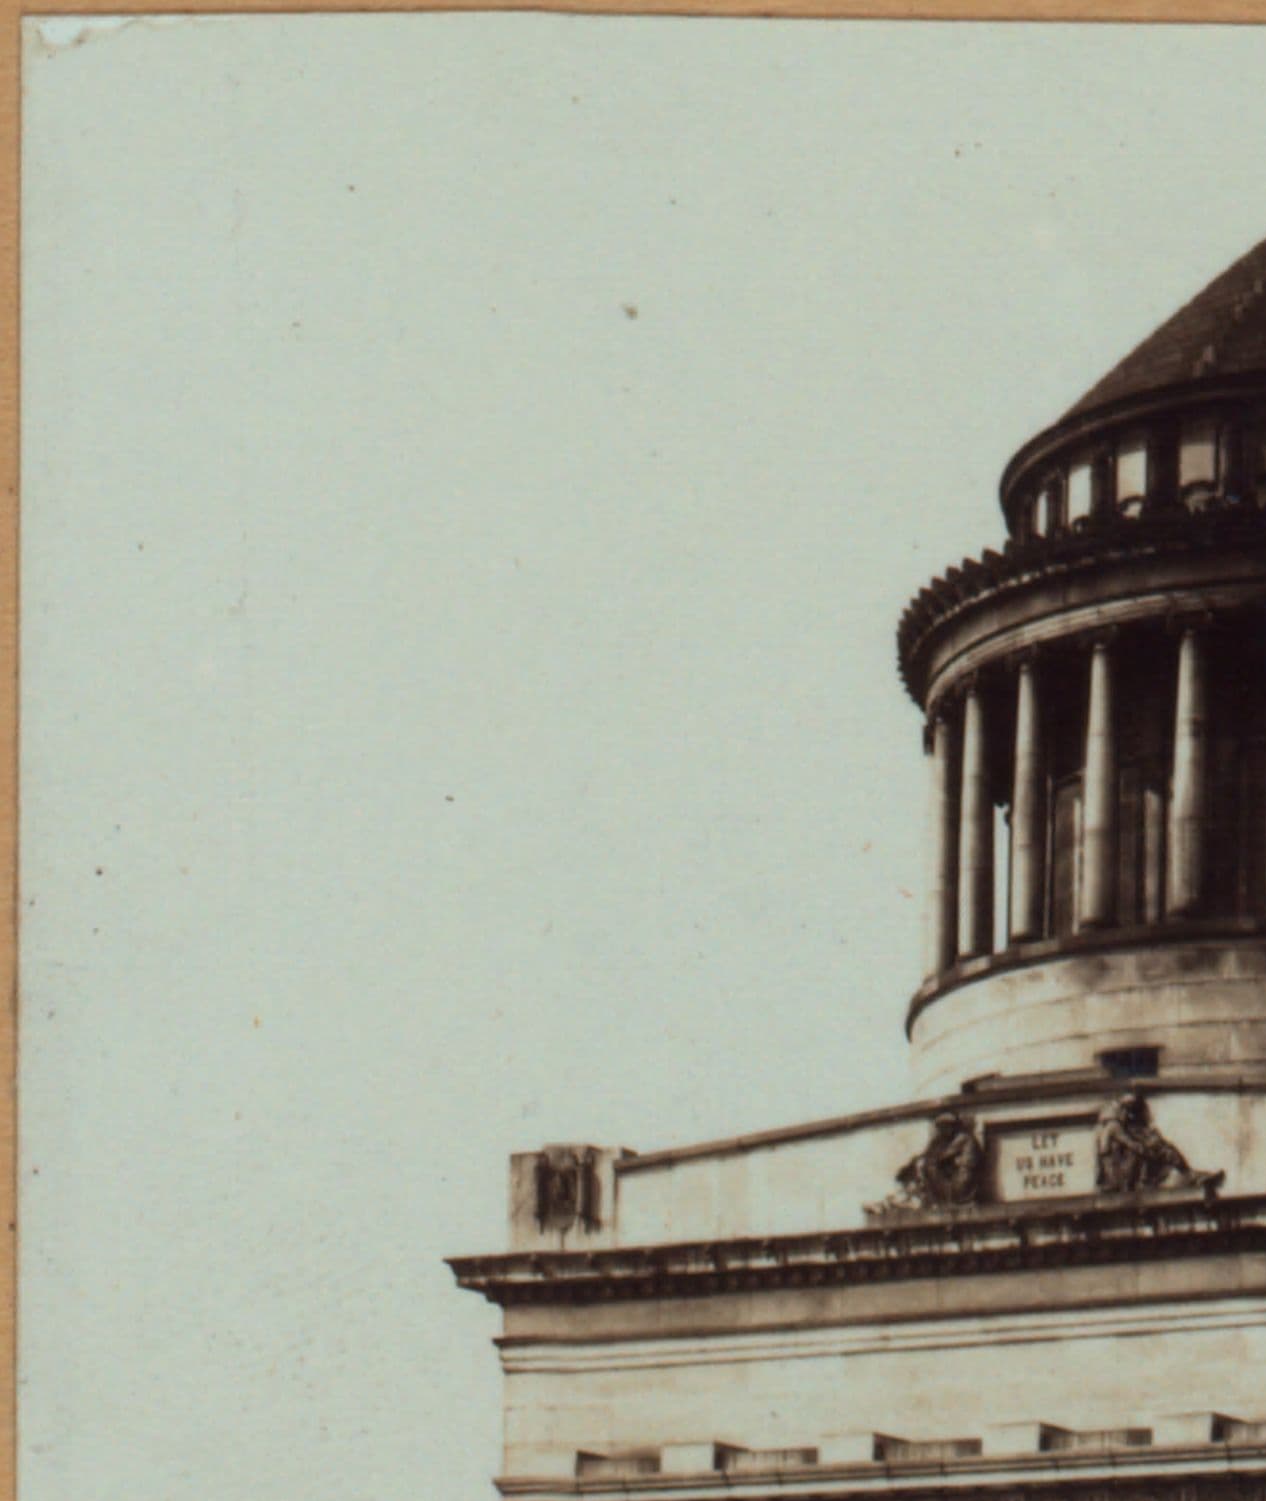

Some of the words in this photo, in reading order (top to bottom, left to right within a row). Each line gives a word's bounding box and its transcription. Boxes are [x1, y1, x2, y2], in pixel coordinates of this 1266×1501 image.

[1031, 1130, 1058, 1149] LET
[1016, 1156, 1033, 1171] US
[1039, 1152, 1073, 1168] HAVE
[1023, 1173, 1065, 1189] PEACE
